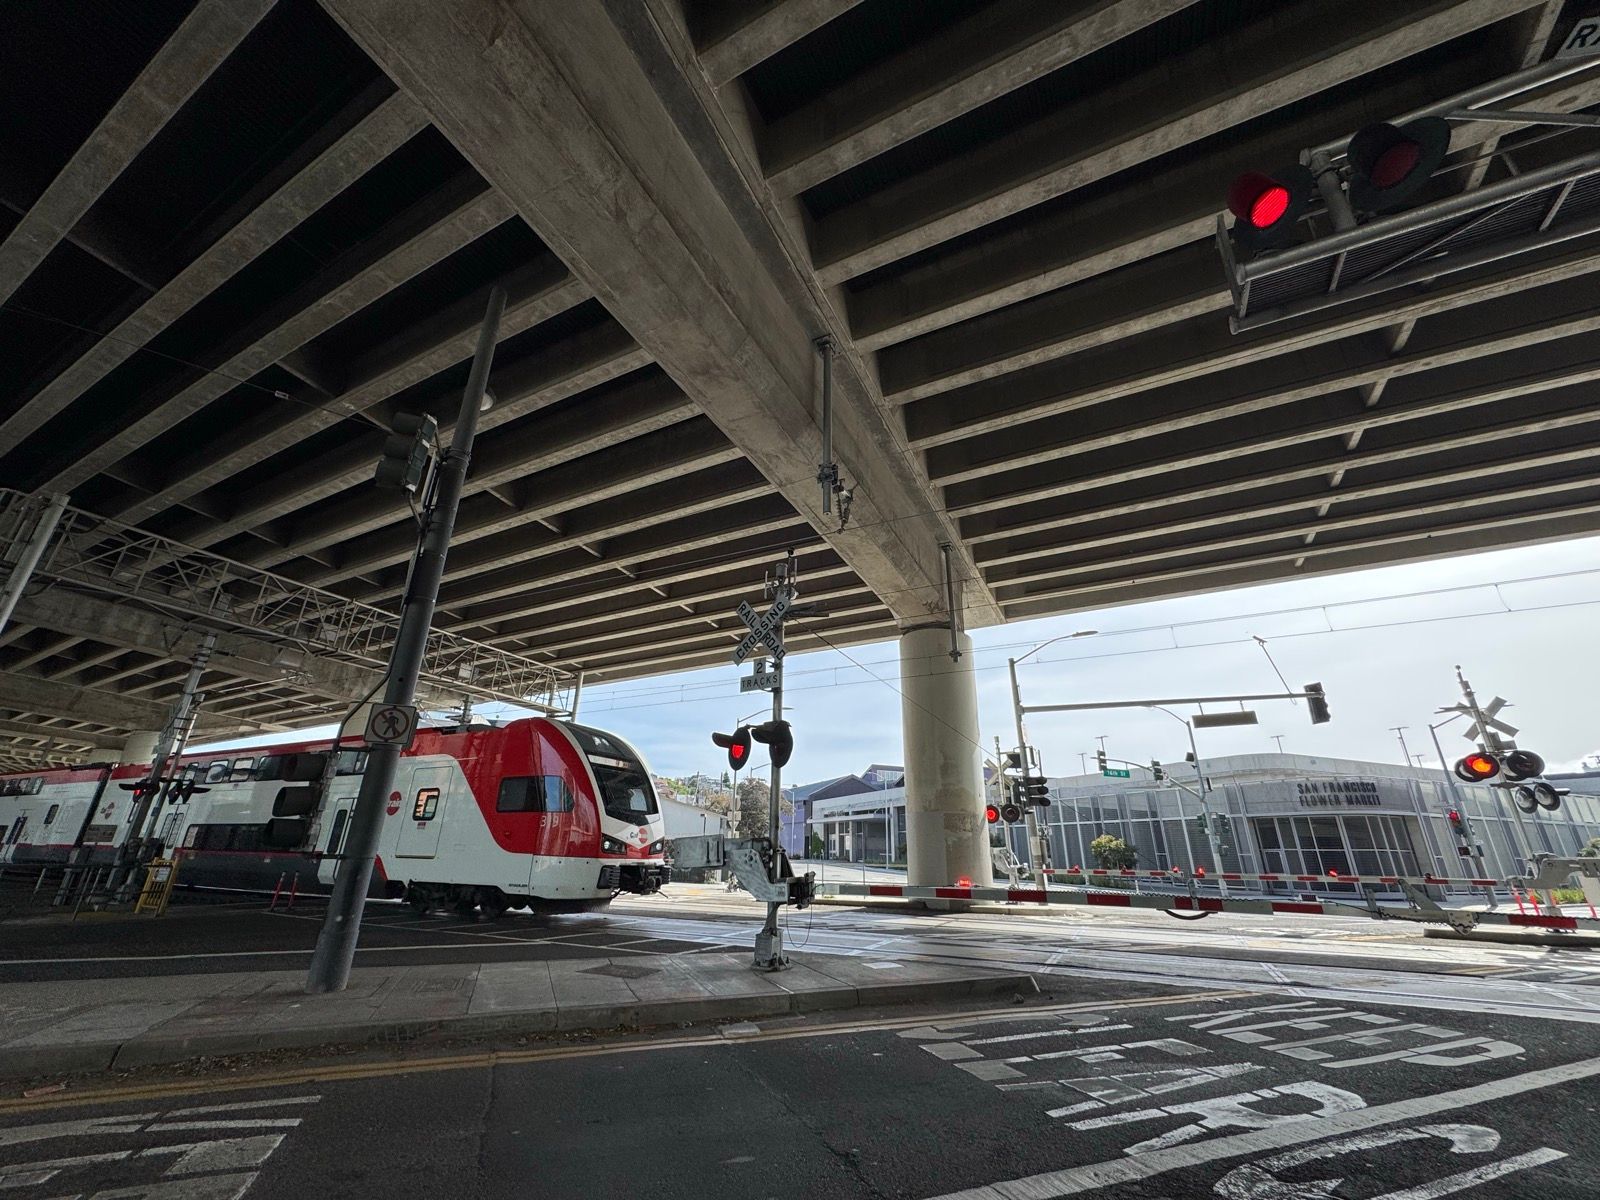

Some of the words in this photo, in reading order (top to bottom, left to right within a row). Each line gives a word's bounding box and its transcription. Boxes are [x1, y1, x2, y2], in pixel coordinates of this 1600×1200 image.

[736, 601, 785, 659] CROSSING
[756, 662, 763, 674] 2
[742, 674, 778, 688] TRACKS
[1297, 783, 1319, 794] SAN
[1322, 781, 1377, 793] FRANCISCO
[1299, 794, 1342, 807] FLOWER
[1345, 794, 1381, 806] MARKET
[1163, 1000, 1525, 1069] KEEP
[895, 1013, 1367, 1156] CLEAR
